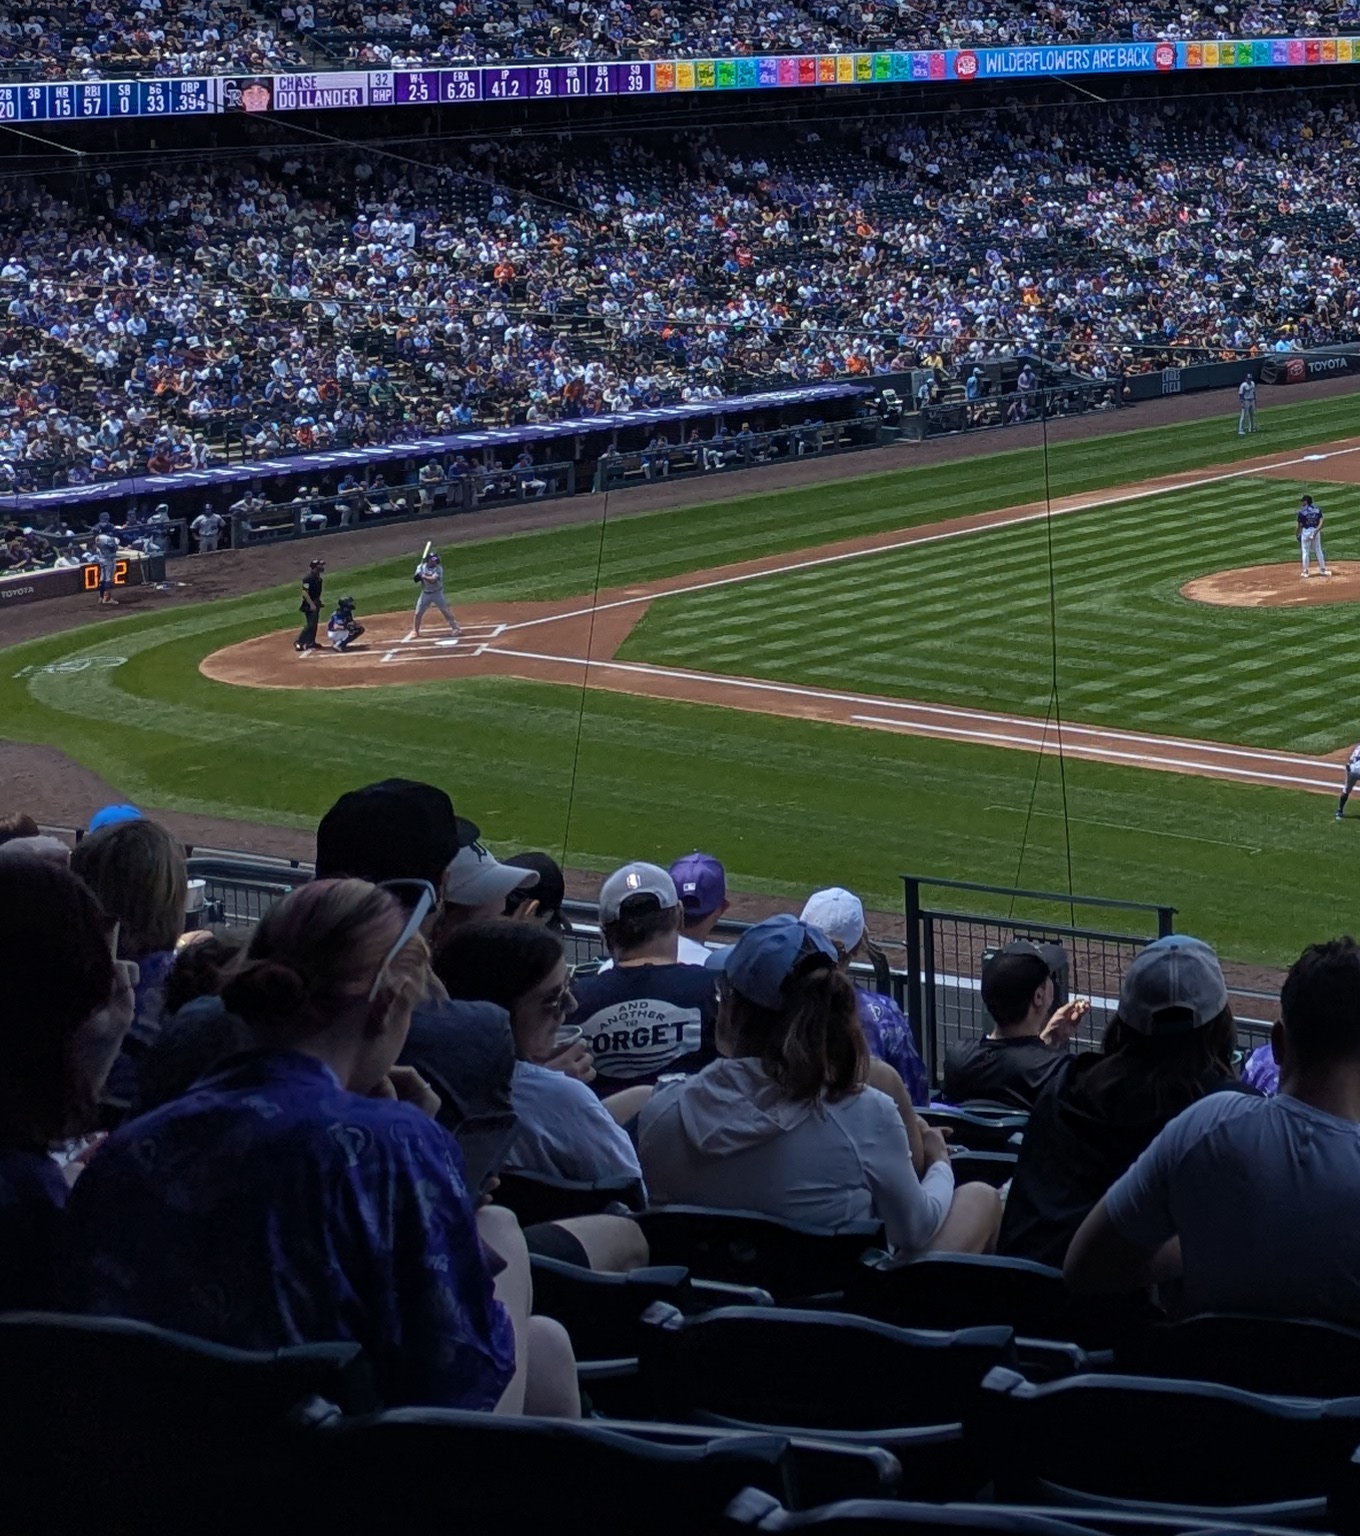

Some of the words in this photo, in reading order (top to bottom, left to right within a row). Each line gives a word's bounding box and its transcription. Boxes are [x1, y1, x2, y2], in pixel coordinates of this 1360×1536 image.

[986, 48, 1091, 73] WILDERFLOWERS
[1093, 48, 1116, 68] ARE
[1117, 47, 1150, 67] BACK
[279, 75, 317, 91] CHASE
[408, 84, 429, 101] 2-5
[447, 82, 476, 99] 6.26
[491, 80, 519, 97] 41.2
[278, 89, 358, 108] DOLLANDER
[1307, 357, 1348, 373] TOYOTA
[1, 586, 35, 599] TOYOTA
[618, 1001, 649, 1013] AND
[599, 1010, 666, 1031] ANOTHER
[582, 1021, 690, 1054] ORGET
